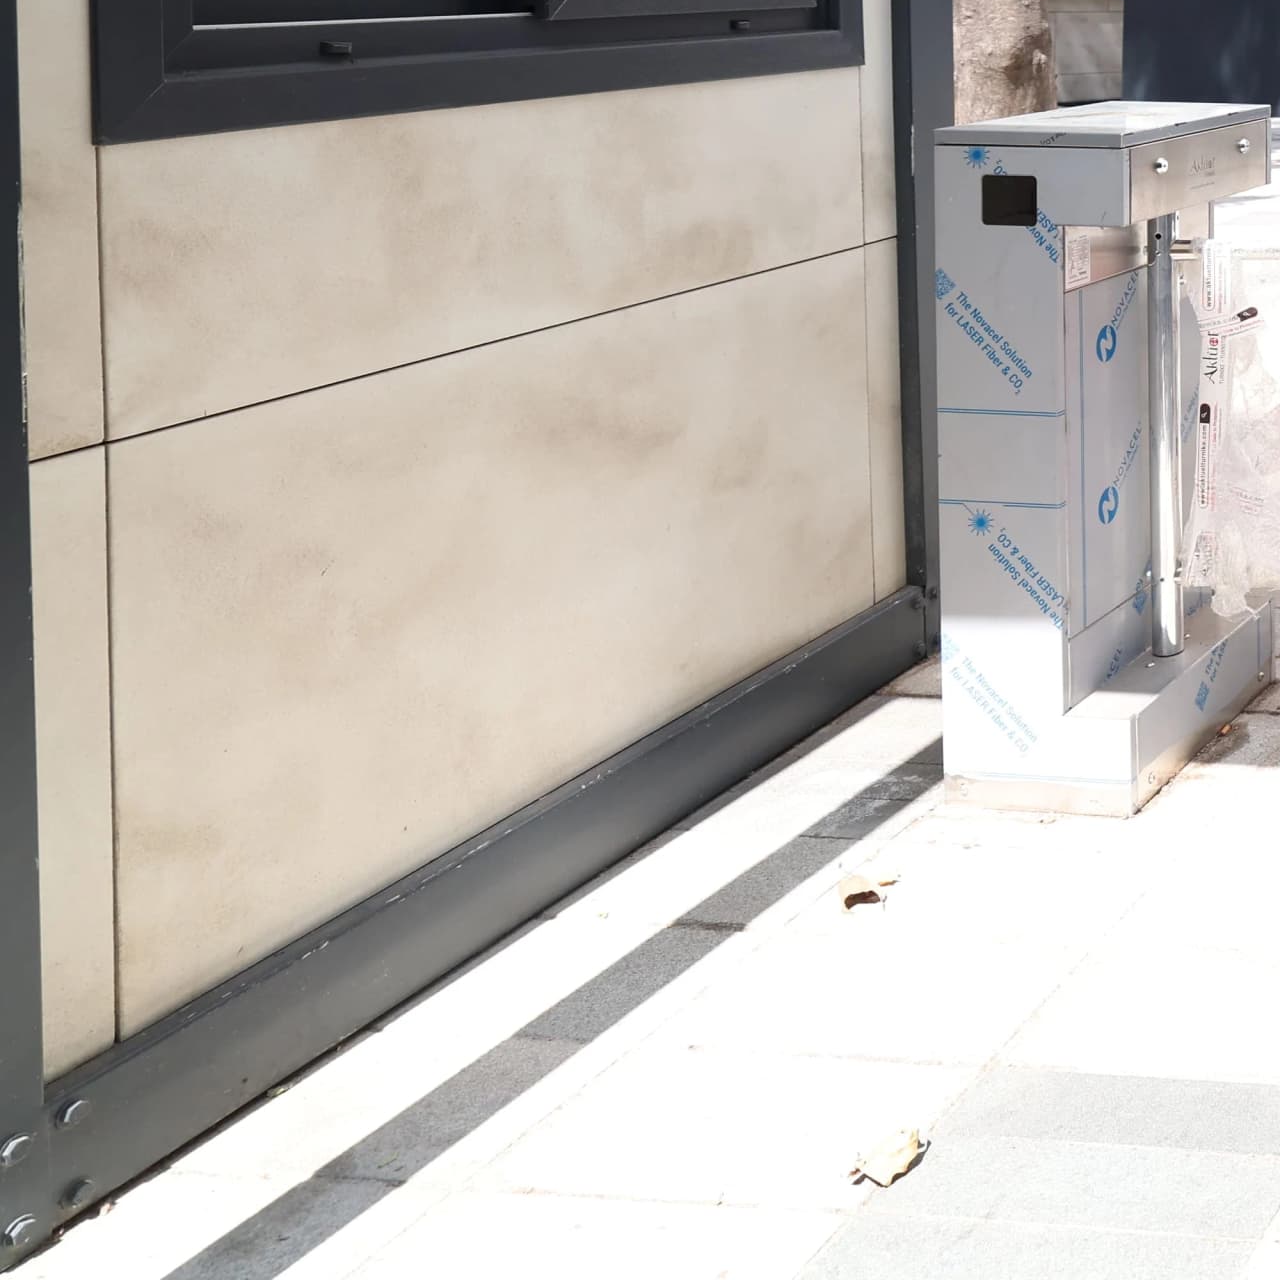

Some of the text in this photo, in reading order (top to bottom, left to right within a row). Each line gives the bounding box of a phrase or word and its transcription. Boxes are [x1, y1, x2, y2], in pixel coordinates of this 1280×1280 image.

[944, 302, 958, 317] for
[957, 315, 984, 346] LASER
[981, 343, 1003, 367] Fiber
[1001, 366, 1010, 376] &
[956, 291, 1032, 378] The Novacel Solution
[988, 544, 1021, 580] Solution
[1010, 547, 1019, 556] &
[1018, 555, 1039, 579] Fiber
[1017, 579, 1050, 614] Novacel
